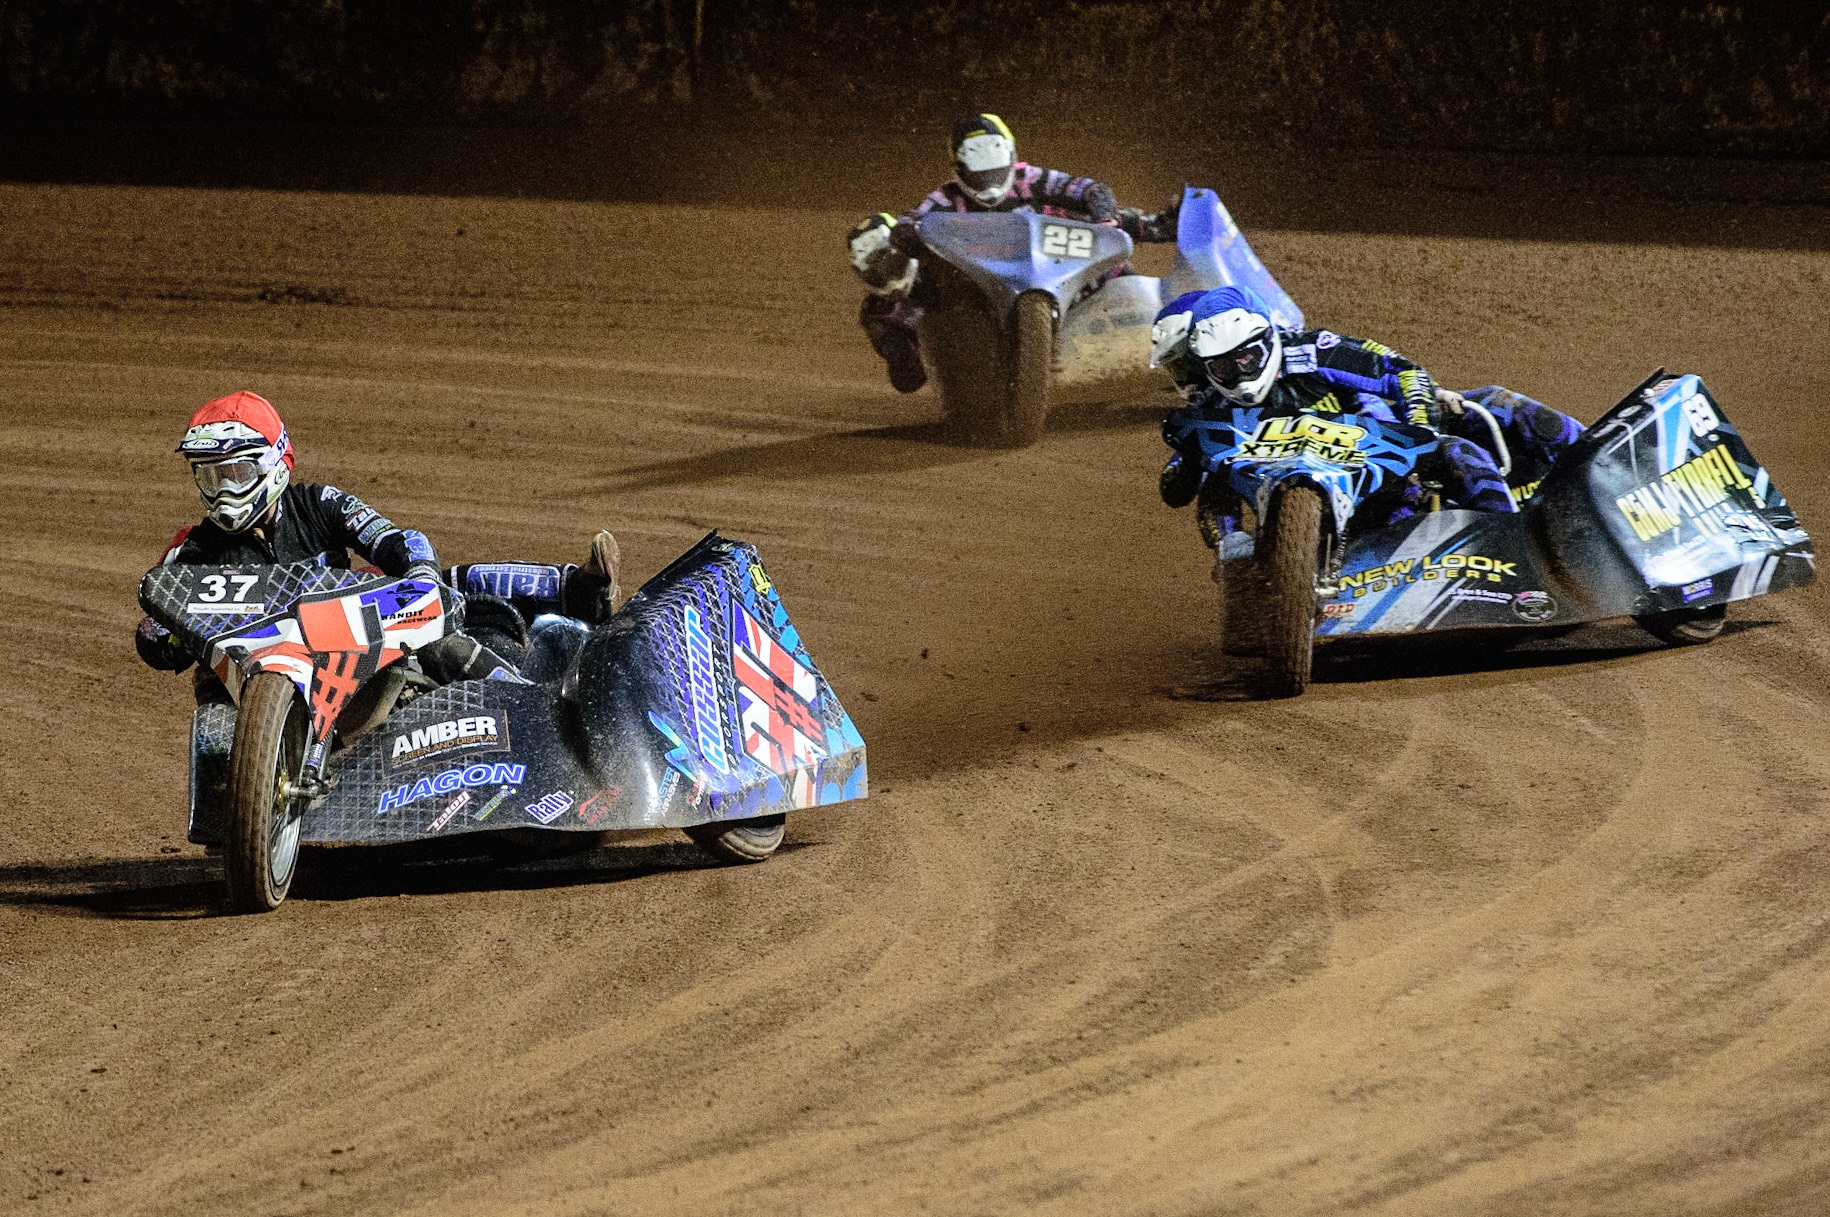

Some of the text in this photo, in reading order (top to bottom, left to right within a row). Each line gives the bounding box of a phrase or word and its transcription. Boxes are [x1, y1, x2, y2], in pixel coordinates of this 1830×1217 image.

[1043, 224, 1094, 258] 22
[1240, 438, 1368, 464] XTREME
[197, 574, 260, 603] 37
[1339, 554, 1518, 592] NEW LOOK
[1352, 569, 1502, 599] BUILDERS
[381, 609, 425, 621] BANDIT
[391, 716, 498, 758] AMBER
[391, 748, 431, 765] SCREEN
[433, 740, 455, 750] AND
[457, 734, 498, 746] DISPLAY
[377, 763, 527, 815] HAGON
[426, 791, 471, 831] Talon
[526, 792, 573, 821] Rally
